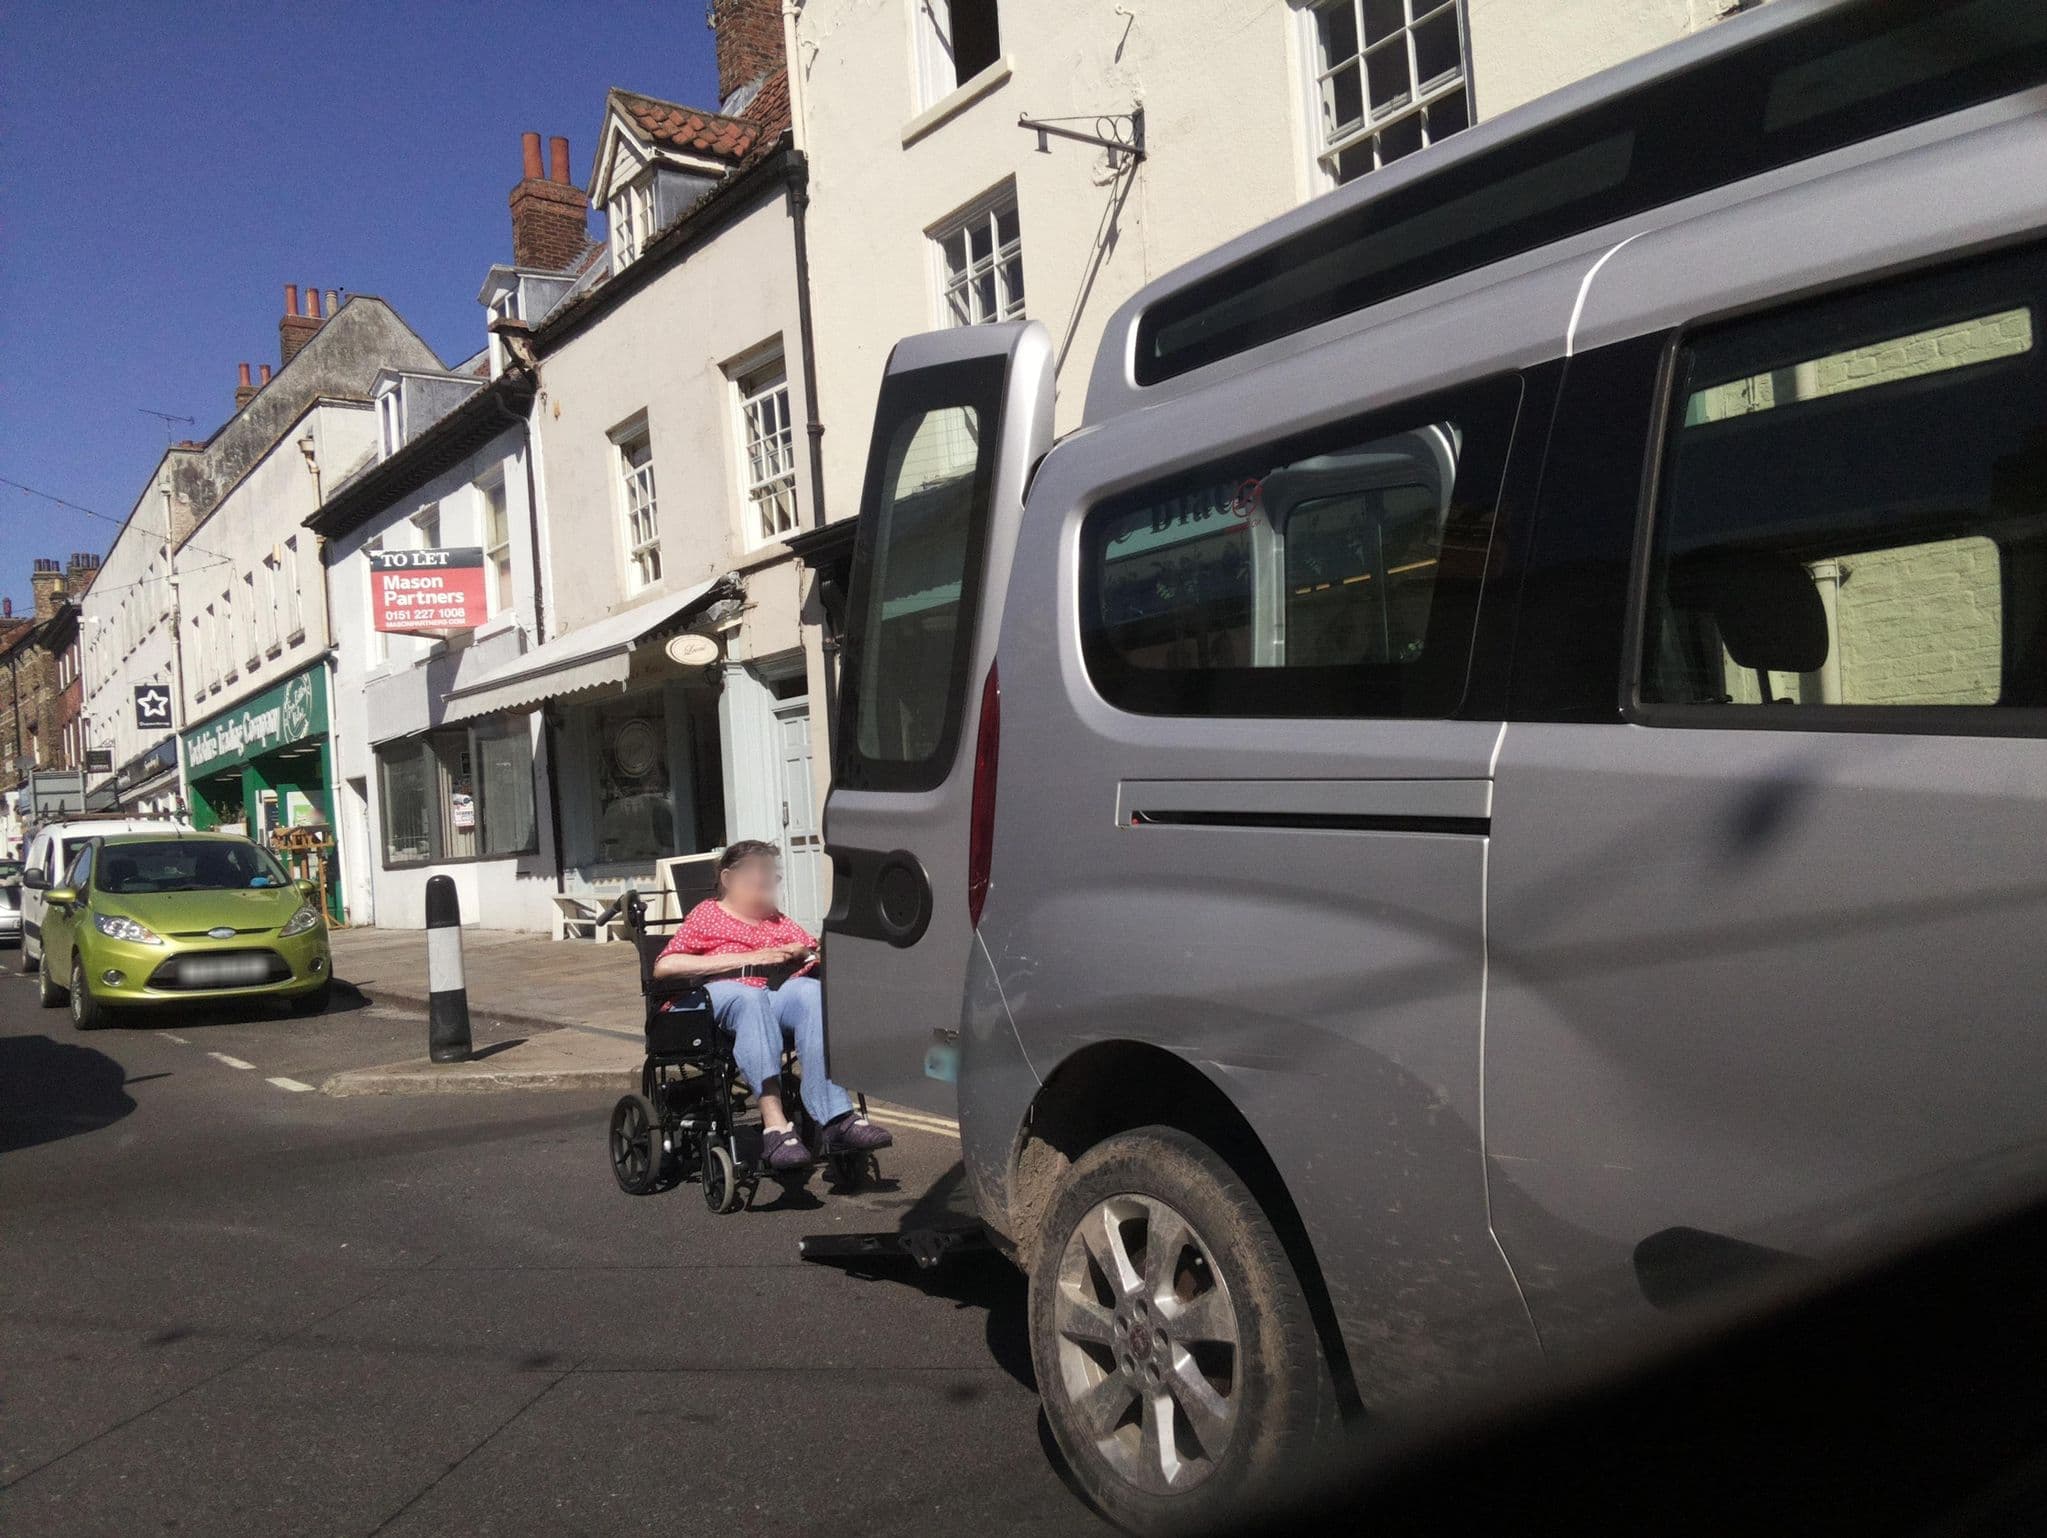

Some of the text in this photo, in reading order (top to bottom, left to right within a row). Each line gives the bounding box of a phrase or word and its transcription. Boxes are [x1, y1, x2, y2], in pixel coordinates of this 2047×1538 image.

[380, 551, 449, 567] TO LET
[383, 575, 443, 590] Mason
[384, 590, 464, 606] Partners
[385, 610, 410, 620] 0151
[414, 609, 434, 619] 227
[216, 719, 244, 757] Trading
[243, 706, 280, 748] Company
